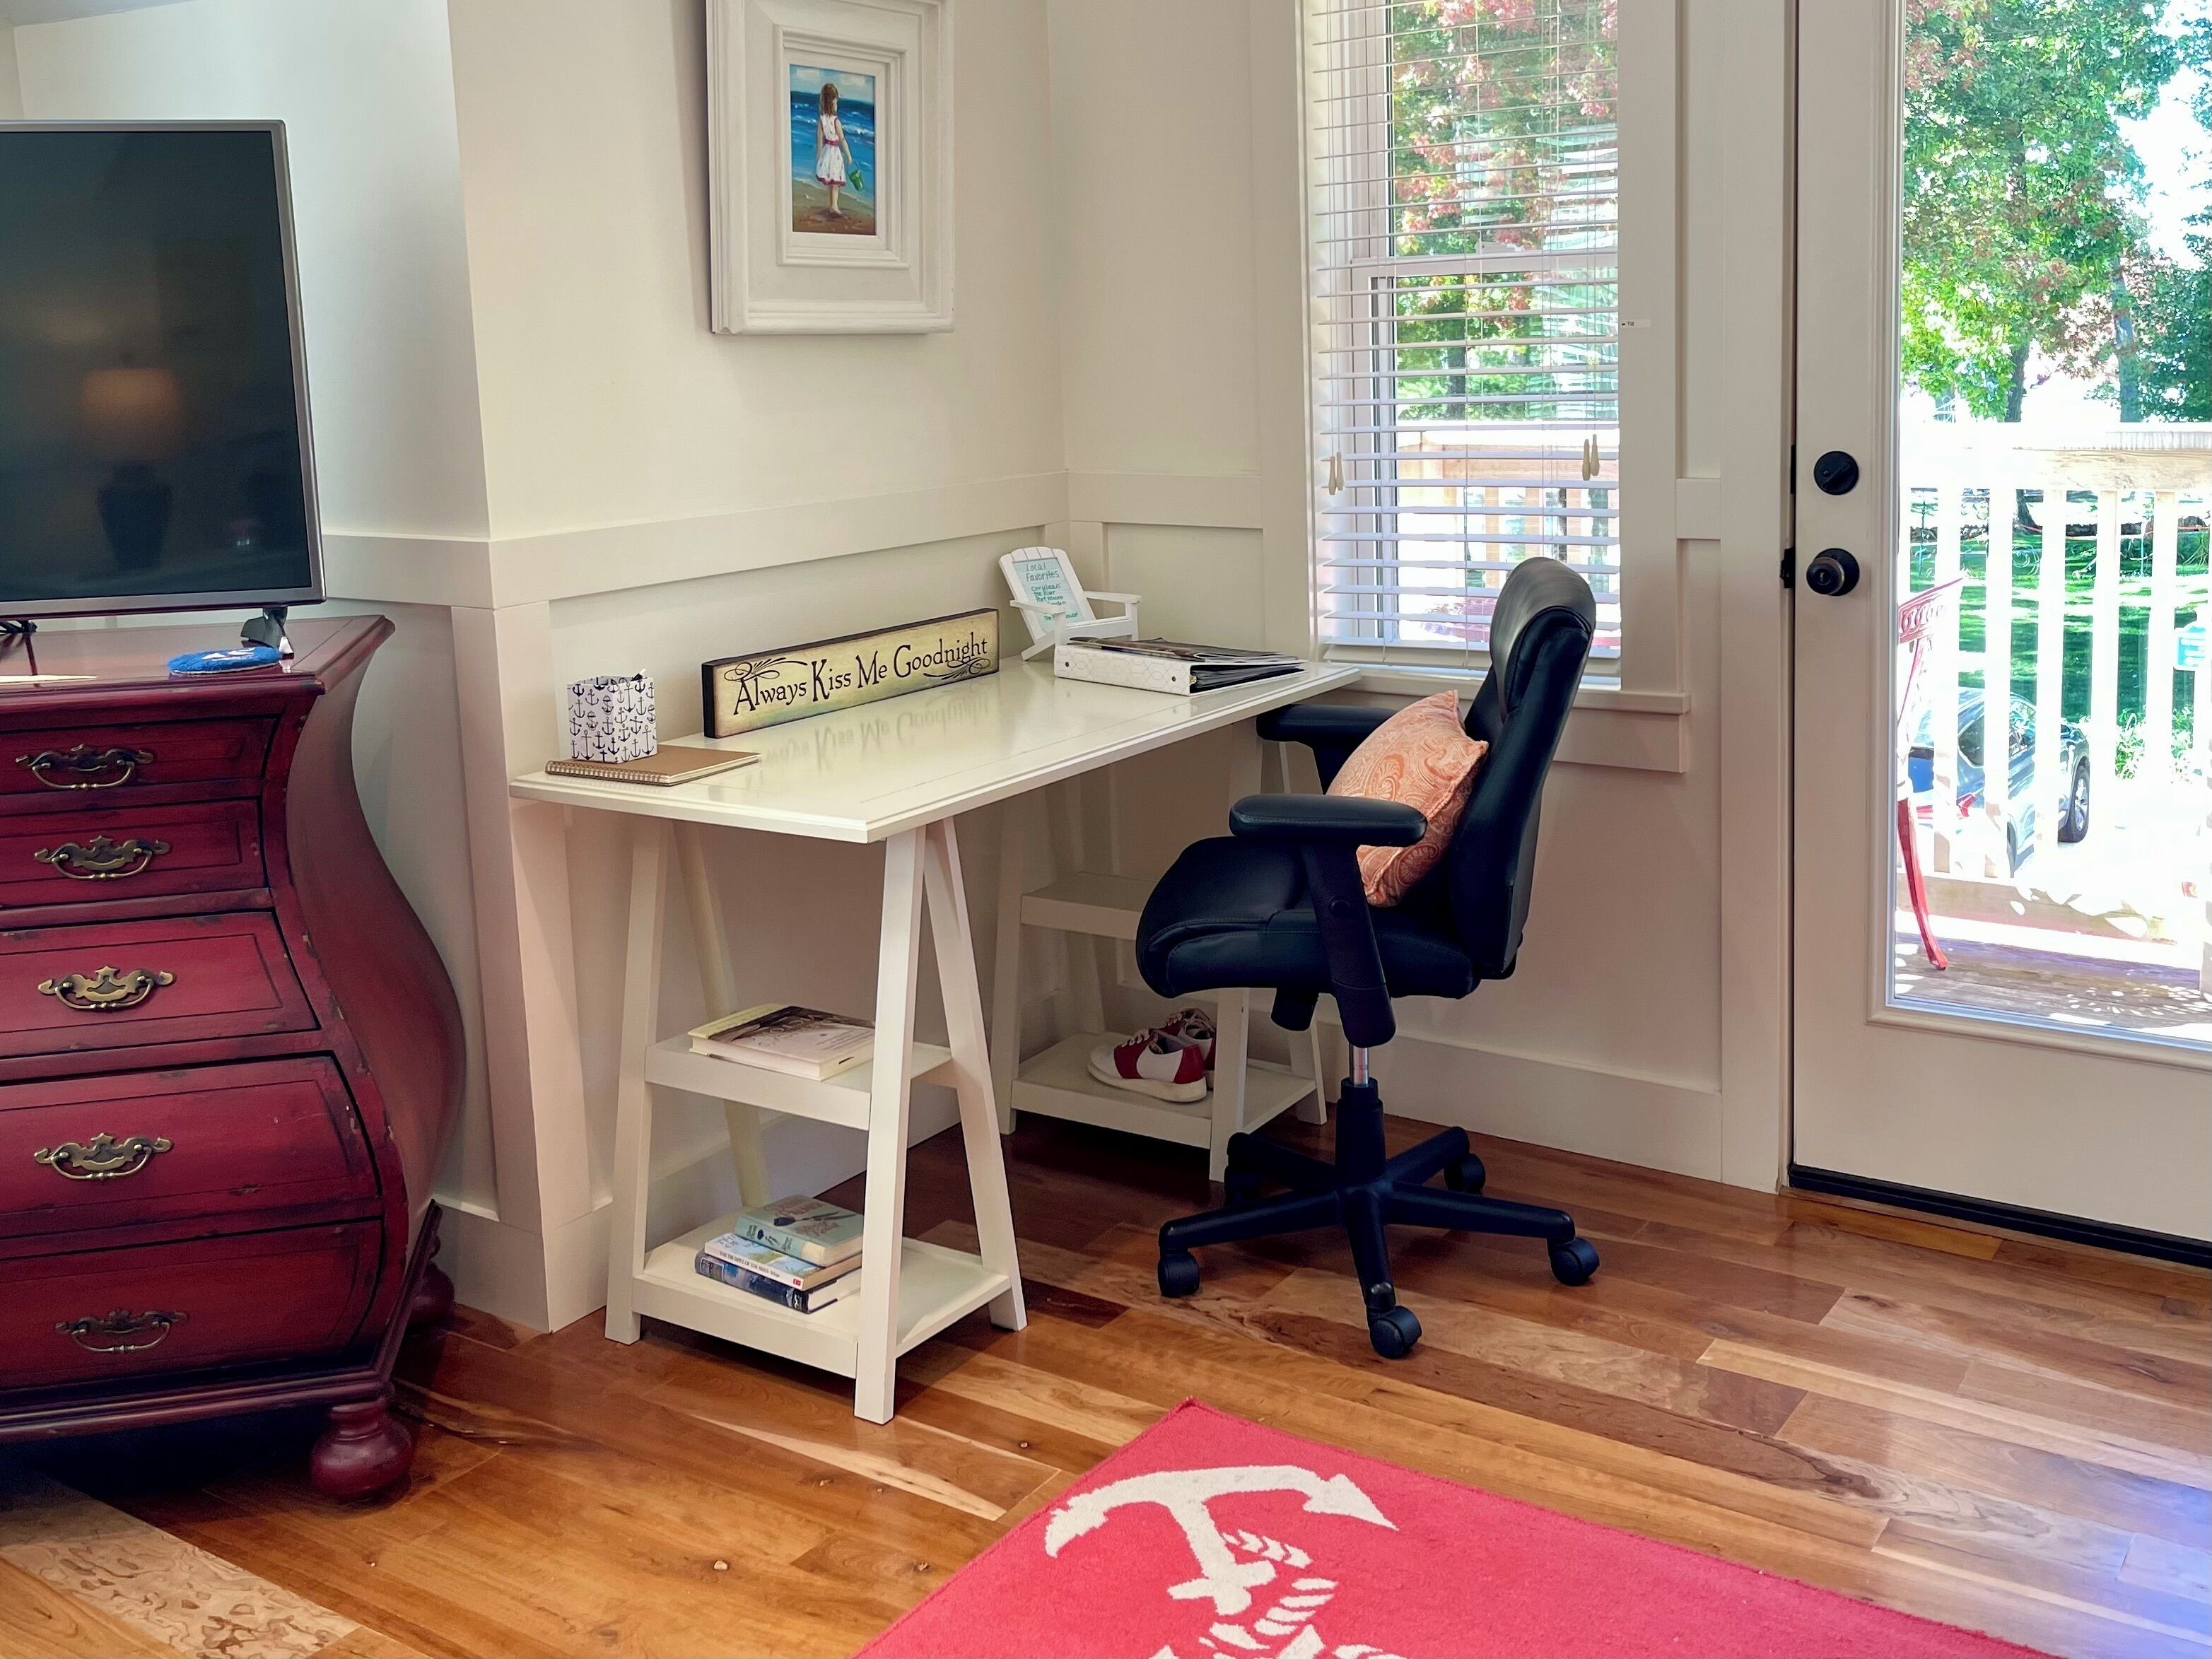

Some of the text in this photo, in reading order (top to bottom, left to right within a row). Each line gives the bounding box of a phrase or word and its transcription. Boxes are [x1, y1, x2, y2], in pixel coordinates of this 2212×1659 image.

[1026, 563, 1046, 572] Local
[1026, 571, 1060, 581] Favorites
[733, 632, 988, 715] Always Kiss Me Goodnight
